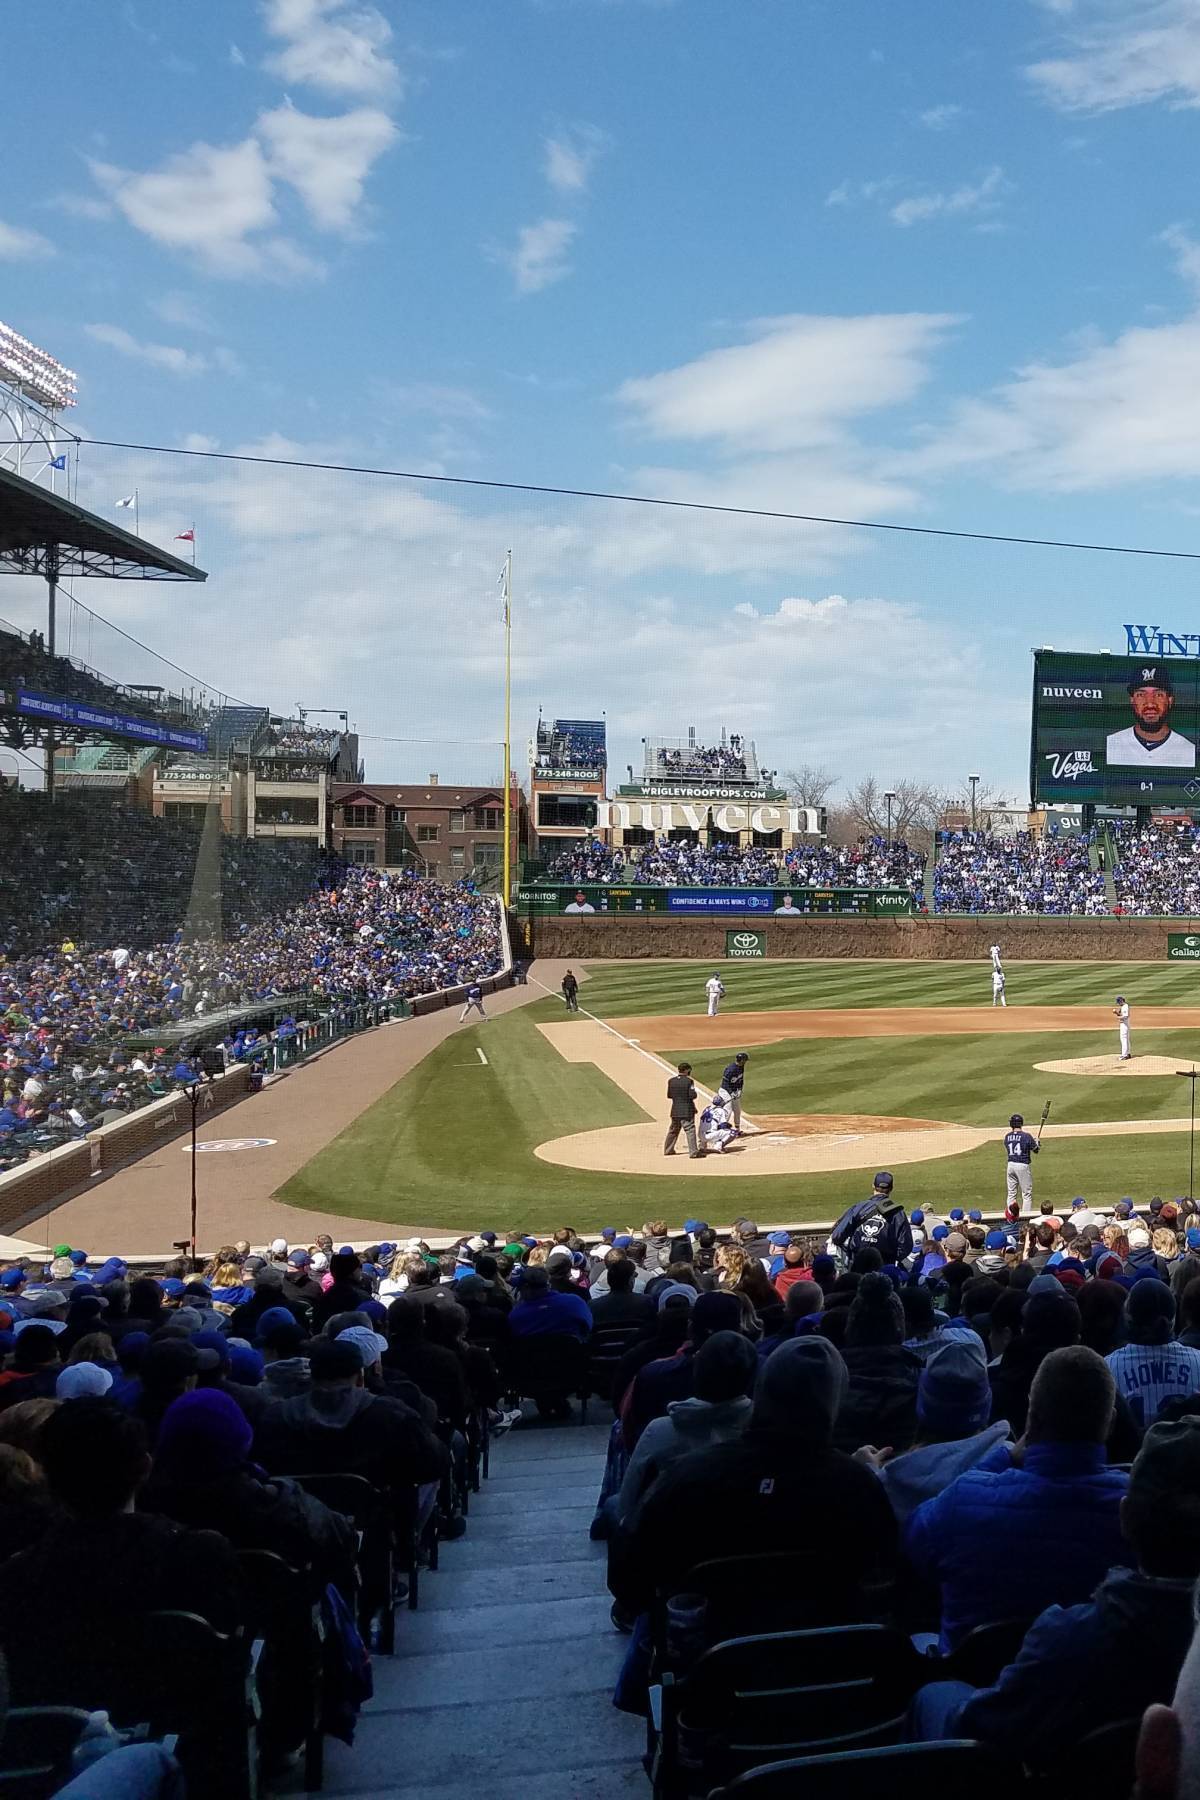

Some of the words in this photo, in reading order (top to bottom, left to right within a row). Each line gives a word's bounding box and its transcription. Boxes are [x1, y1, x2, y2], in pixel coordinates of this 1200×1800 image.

[1043, 687, 1102, 699] nuveen
[1075, 752, 1090, 761] LAS
[1046, 753, 1098, 780] Vegas
[537, 770, 599, 778] 773-248-ROOF
[641, 787, 766, 799] WRIGLEYROOFTOPS.COM
[593, 799, 821, 834] nuveen
[876, 894, 909, 907] xfinity
[1008, 1143, 1021, 1155] 14
